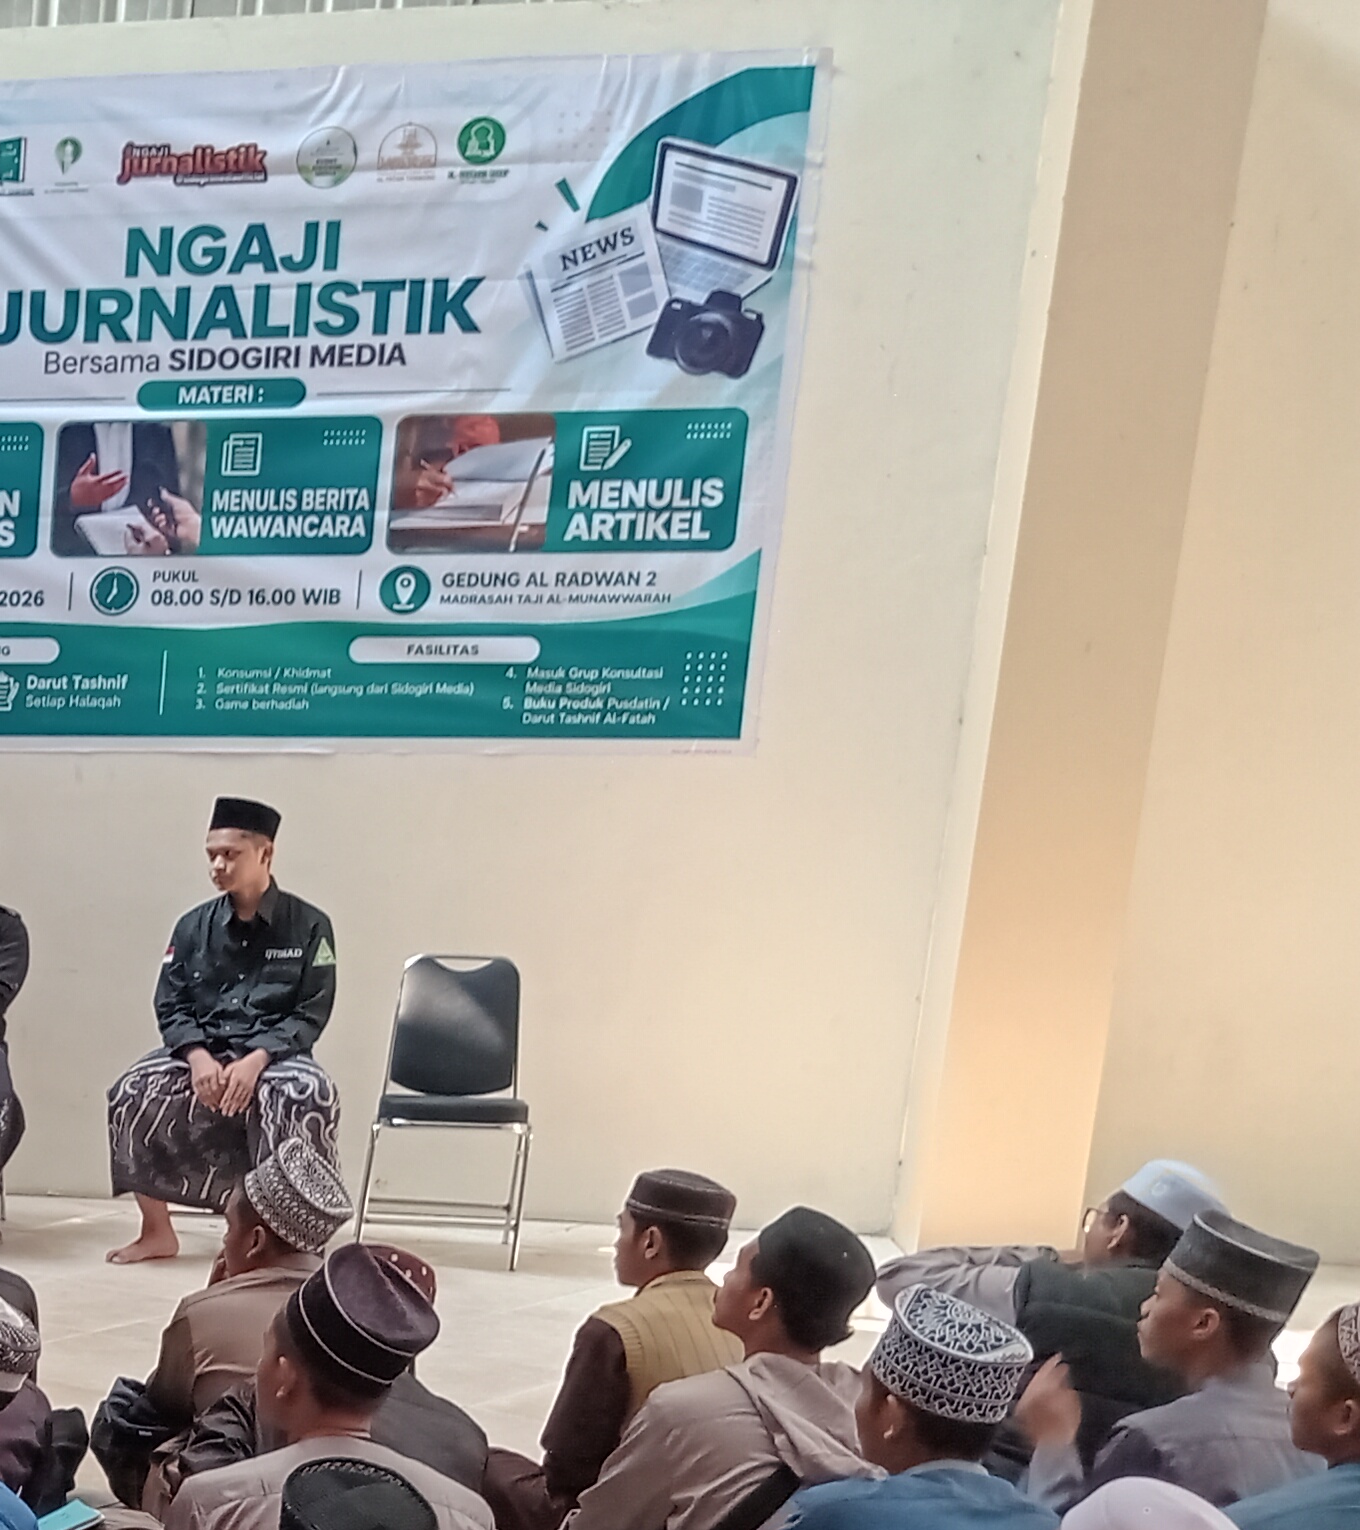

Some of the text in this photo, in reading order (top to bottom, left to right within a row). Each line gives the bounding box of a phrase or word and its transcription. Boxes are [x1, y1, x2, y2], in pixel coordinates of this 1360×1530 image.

[117, 142, 266, 185] jurnalistik
[124, 219, 342, 278] NGAJI
[559, 227, 635, 272] NEWS
[44, 342, 408, 375] Bersama SIDOGIRI MEDIA
[211, 487, 370, 512] MENULIS BERITA
[567, 477, 725, 510] MENULIS
[210, 514, 366, 539] WAWANCARA
[563, 511, 711, 542] ARTIKEL
[152, 570, 199, 583] PUKUL
[441, 571, 657, 588] GEDUNG AL RADWAN 2
[150, 587, 341, 608] 08.00 S/D 16.00 WIB
[439, 593, 513, 605] MADRASAH
[517, 593, 544, 605] TAJI
[407, 644, 480, 656] FASILITAS
[26, 673, 129, 690] Darut Tashnif
[217, 667, 272, 679] Konsumsi
[283, 667, 332, 679] Khidmat
[526, 666, 566, 679] Masuk
[568, 667, 599, 681] Grup
[601, 666, 664, 680] Konsultasi
[366, 682, 388, 695] dari
[25, 694, 122, 710] Setiap Halaqah
[523, 697, 556, 710] Buku
[558, 696, 603, 710] Produk
[607, 696, 660, 710] Pusdatin
[522, 712, 555, 725] Darut
[558, 712, 601, 725] Tashnif
